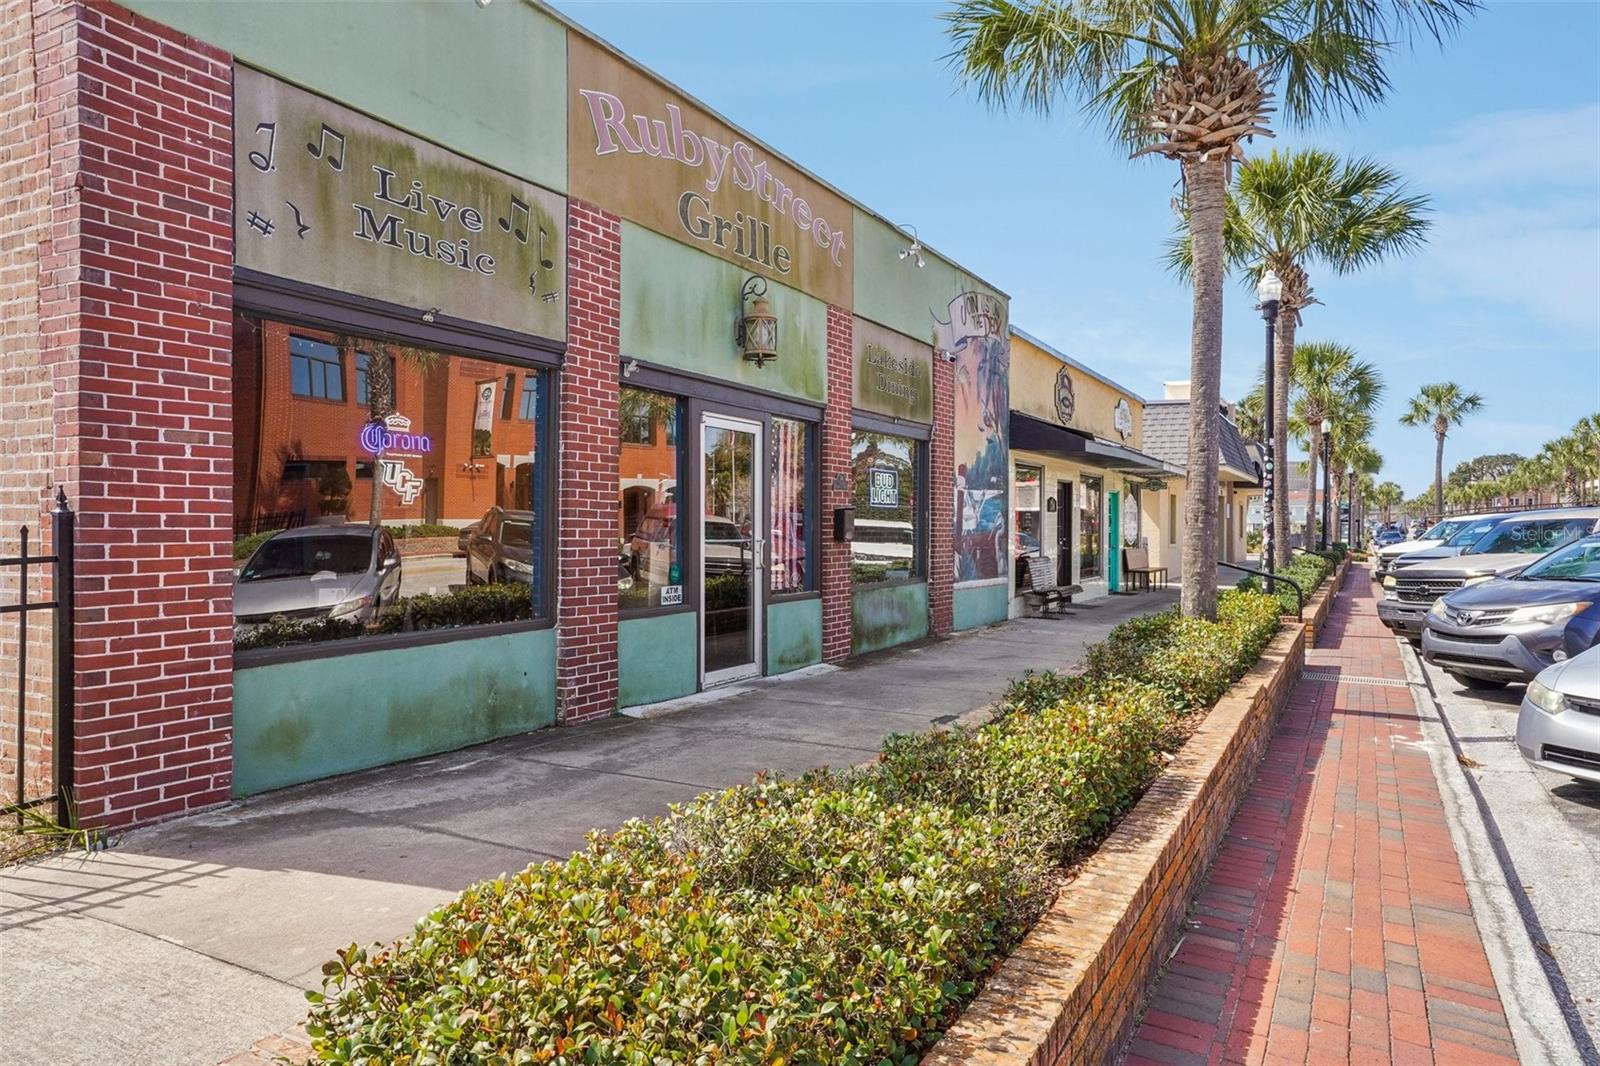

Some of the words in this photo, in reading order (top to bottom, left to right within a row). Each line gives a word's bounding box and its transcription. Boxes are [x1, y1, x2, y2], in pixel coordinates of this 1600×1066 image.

[372, 165, 484, 233] Live
[352, 203, 496, 276] Music
[678, 190, 792, 275] Grille
[360, 424, 432, 456] Corona
[379, 459, 424, 505] UCF
[871, 487, 897, 504] LIGHT
[874, 472, 894, 488] BUD
[662, 594, 682, 603] INSIDE
[665, 587, 679, 595] ATM
